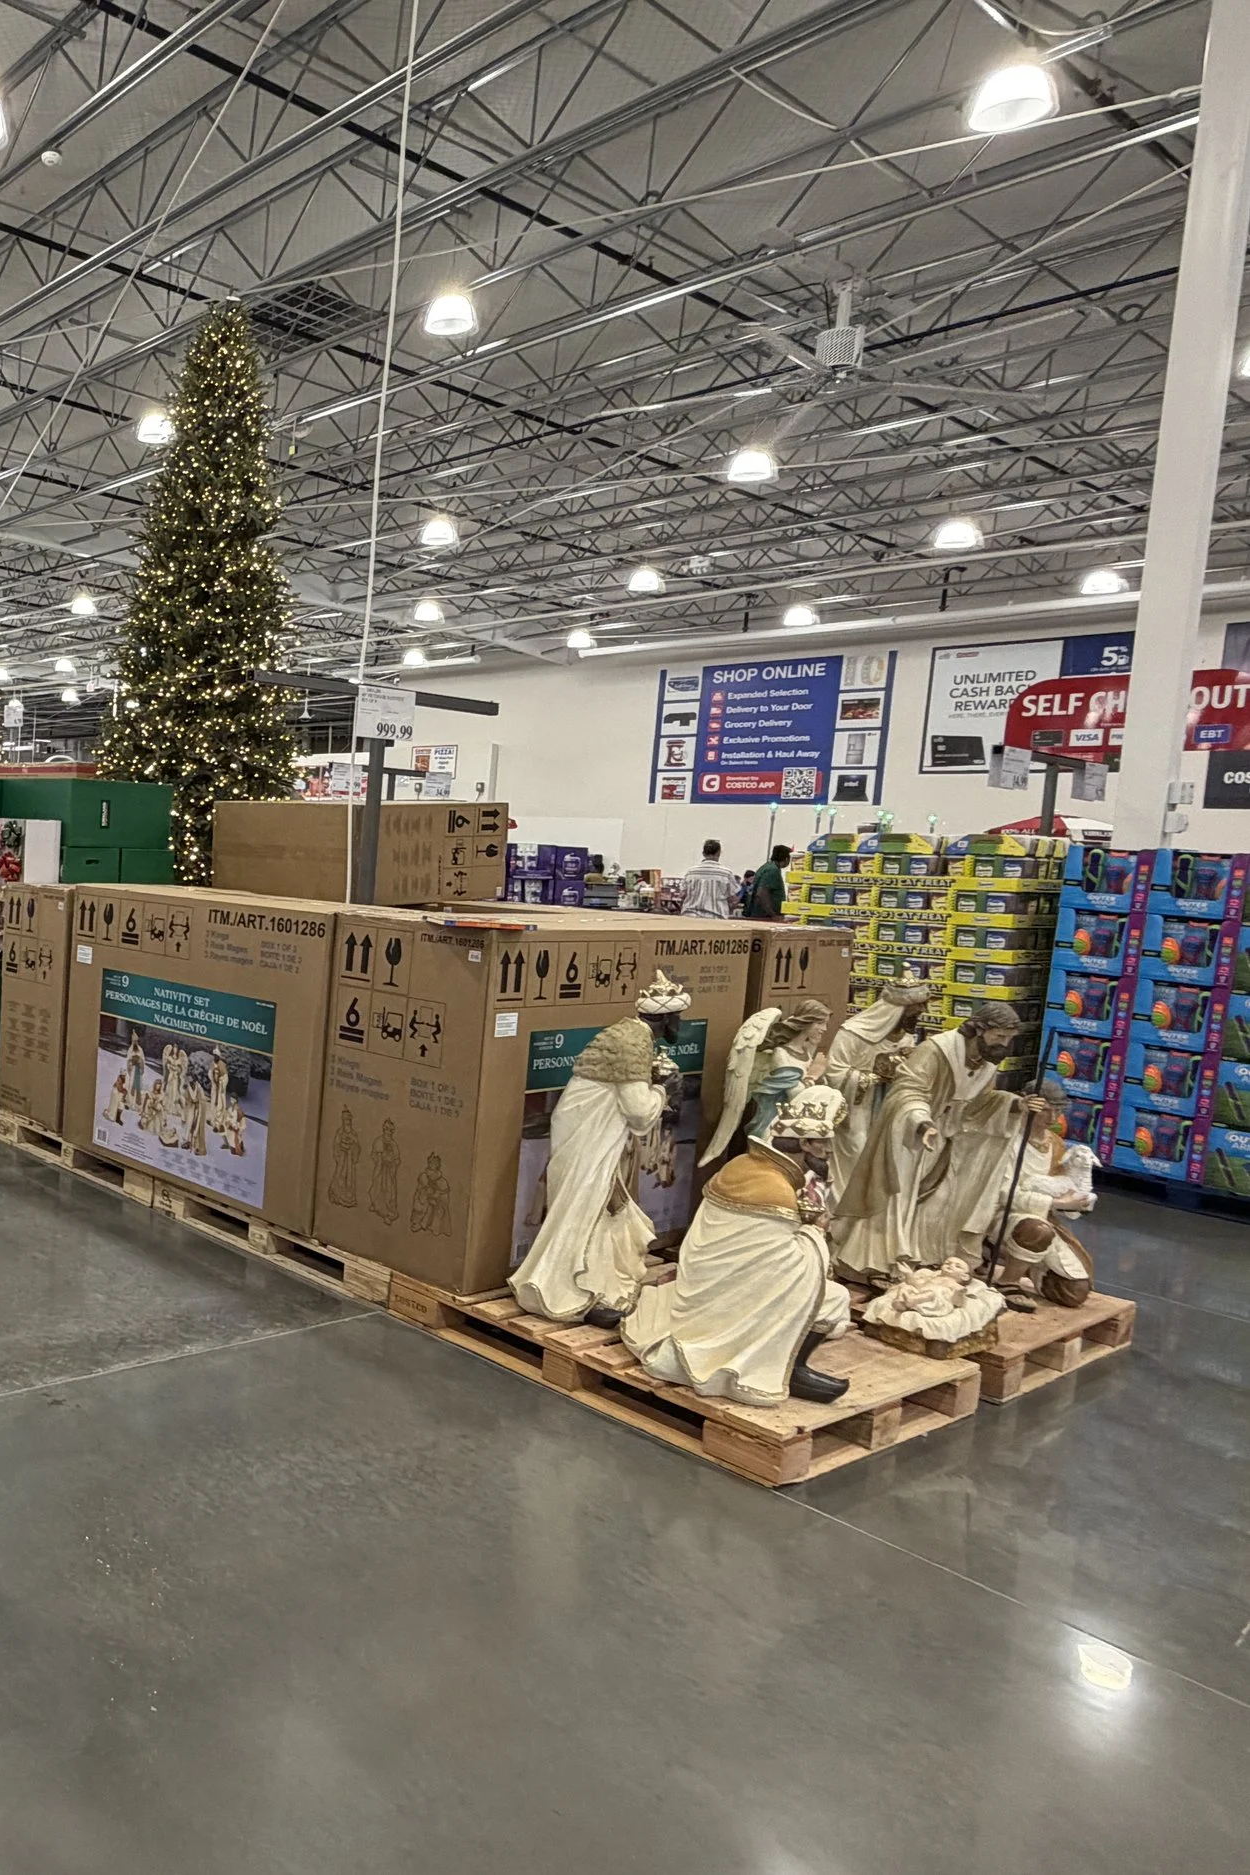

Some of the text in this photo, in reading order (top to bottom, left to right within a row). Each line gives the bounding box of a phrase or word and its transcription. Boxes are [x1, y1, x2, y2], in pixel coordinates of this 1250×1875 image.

[712, 662, 827, 684] SHOP ONLINE
[953, 669, 1037, 685] UNLIMITED
[727, 687, 809, 700] Expanded Selection
[949, 684, 1031, 699] CASH BAC
[726, 702, 814, 715] Delivery to Your Door
[1021, 692, 1086, 717] SELF
[376, 722, 413, 739] 999.99
[724, 719, 793, 729] Grocery Delivery
[722, 734, 811, 744] Exclusive Promotions
[1074, 733, 1099, 742] VISA
[1199, 729, 1225, 739] EBT
[721, 749, 821, 760] Installation & Haul Away
[725, 781, 776, 789] COSTCO APP
[900, 878, 918, 887] CAT
[919, 879, 952, 887] TREAT
[894, 911, 913, 919] CAT
[914, 913, 947, 921] TREAT
[916, 946, 947, 955] TREAT
[121, 974, 130, 988] 9
[153, 986, 211, 1008] NATIVITY SET
[104, 989, 161, 1011] PERSONNAGES
[162, 1001, 174, 1013] DE
[175, 1005, 187, 1017] LA
[226, 1017, 240, 1029] DE
[153, 1013, 208, 1035] NACIMIENTO
[554, 1033, 564, 1049] 9
